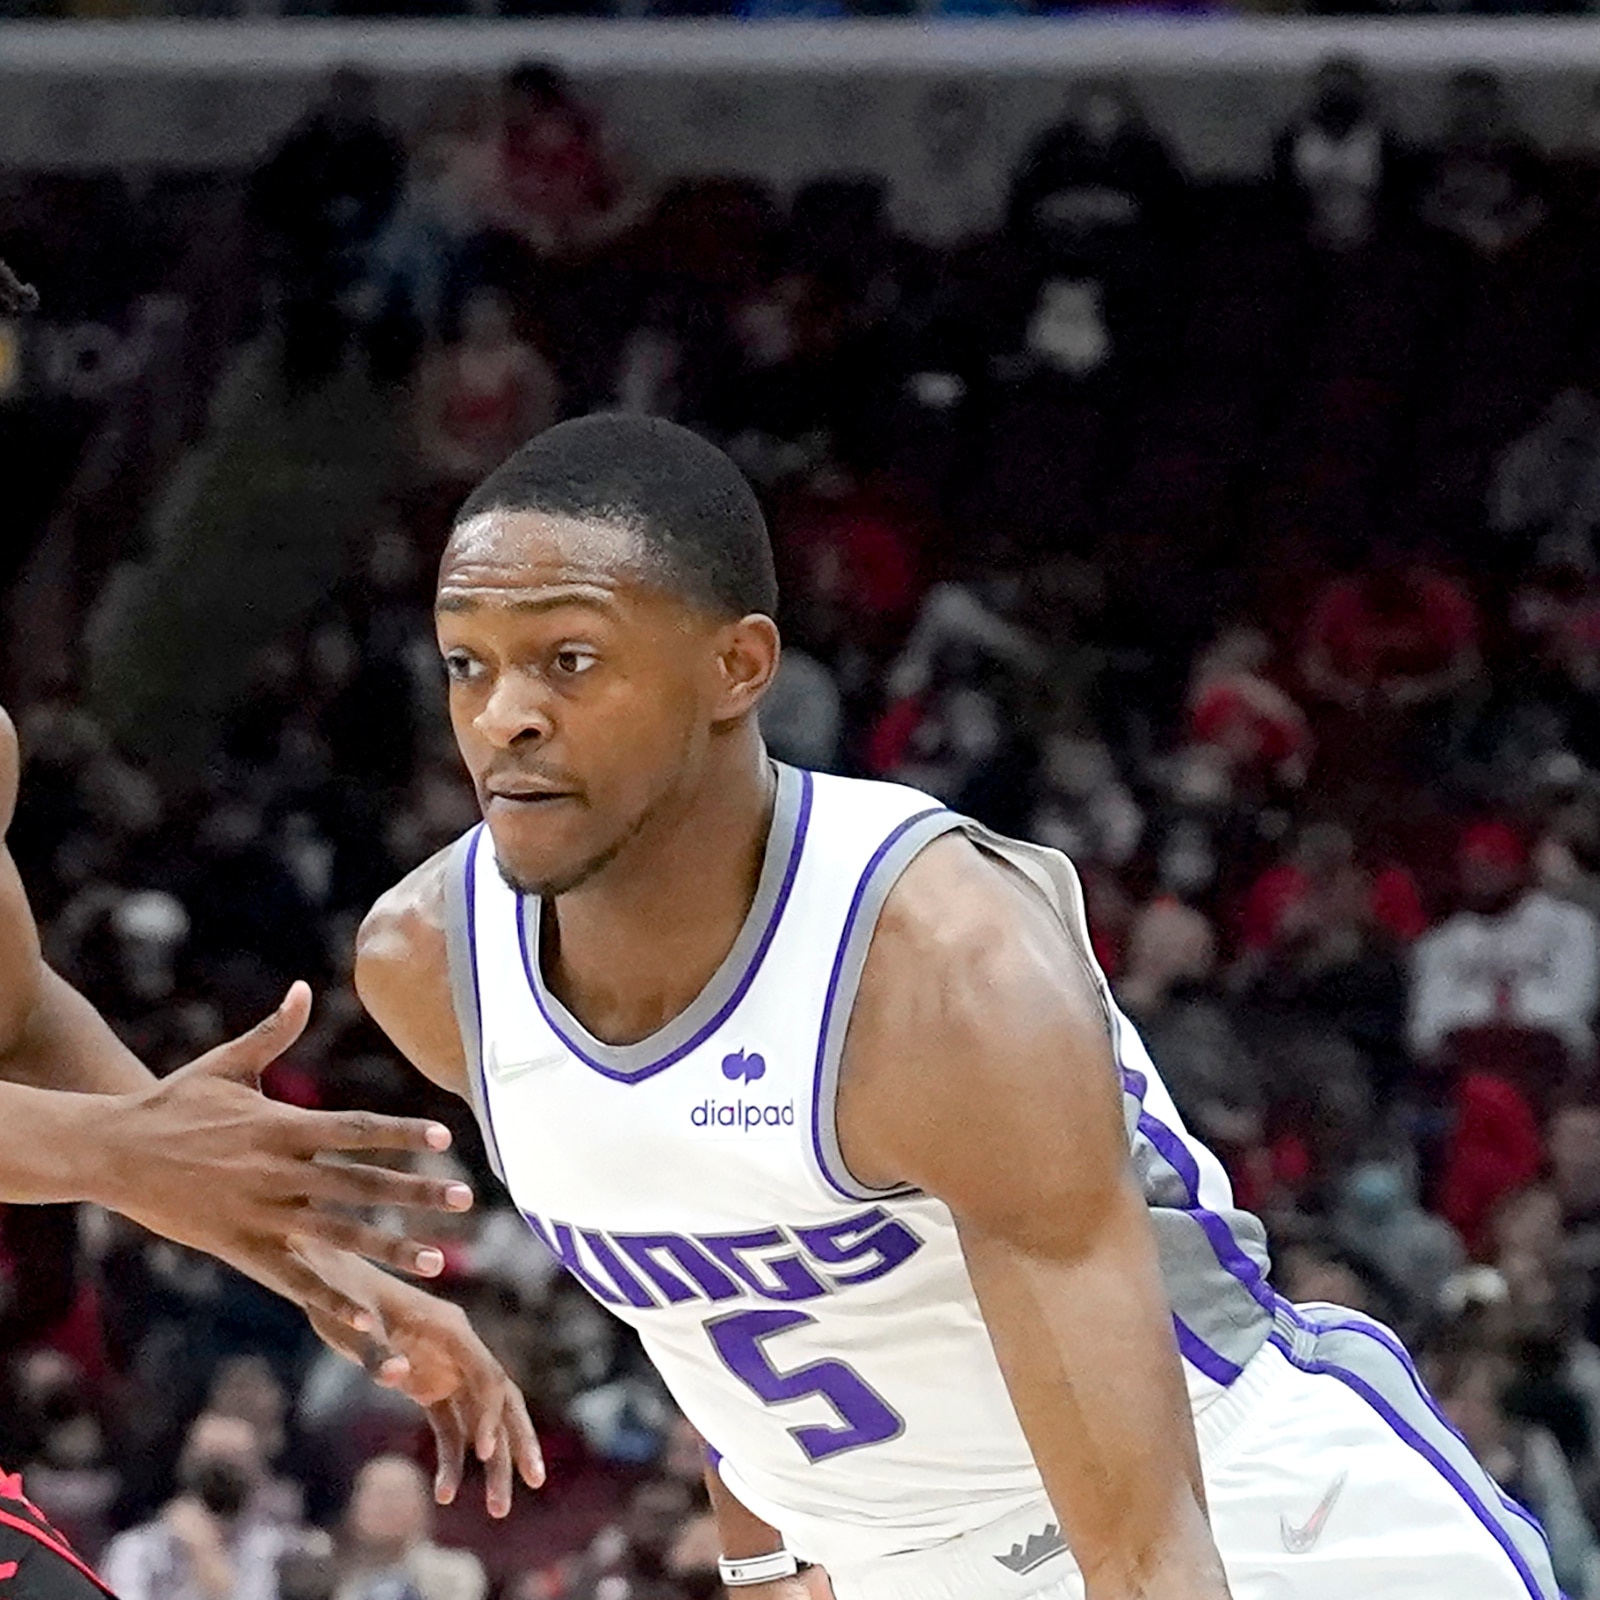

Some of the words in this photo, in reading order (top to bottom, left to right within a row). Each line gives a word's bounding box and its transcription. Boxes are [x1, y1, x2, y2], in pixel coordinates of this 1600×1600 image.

[690, 1097, 795, 1134] dialpad
[516, 1204, 928, 1310] KINGS
[701, 1308, 908, 1466] 5
